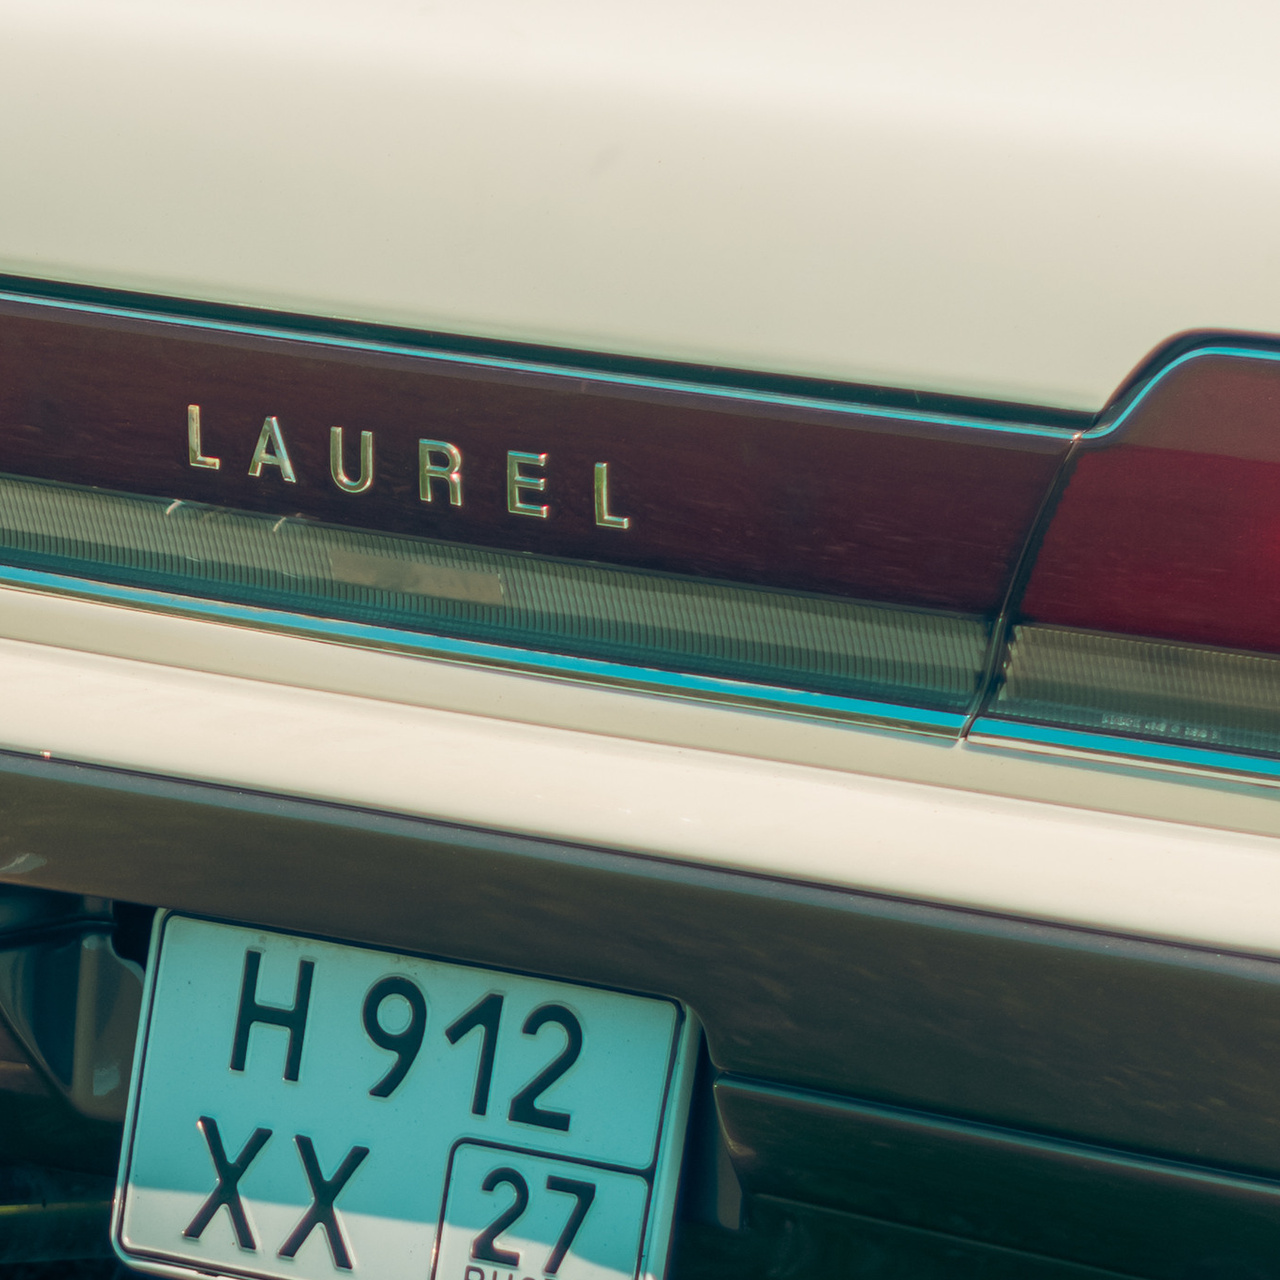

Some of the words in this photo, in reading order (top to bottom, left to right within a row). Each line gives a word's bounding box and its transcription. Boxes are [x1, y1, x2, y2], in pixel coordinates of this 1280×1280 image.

[187, 404, 629, 529] LAUREL
[229, 949, 315, 1083] H
[361, 974, 584, 1132] 912
[182, 1115, 371, 1271] XX
[471, 1166, 597, 1276] 27
